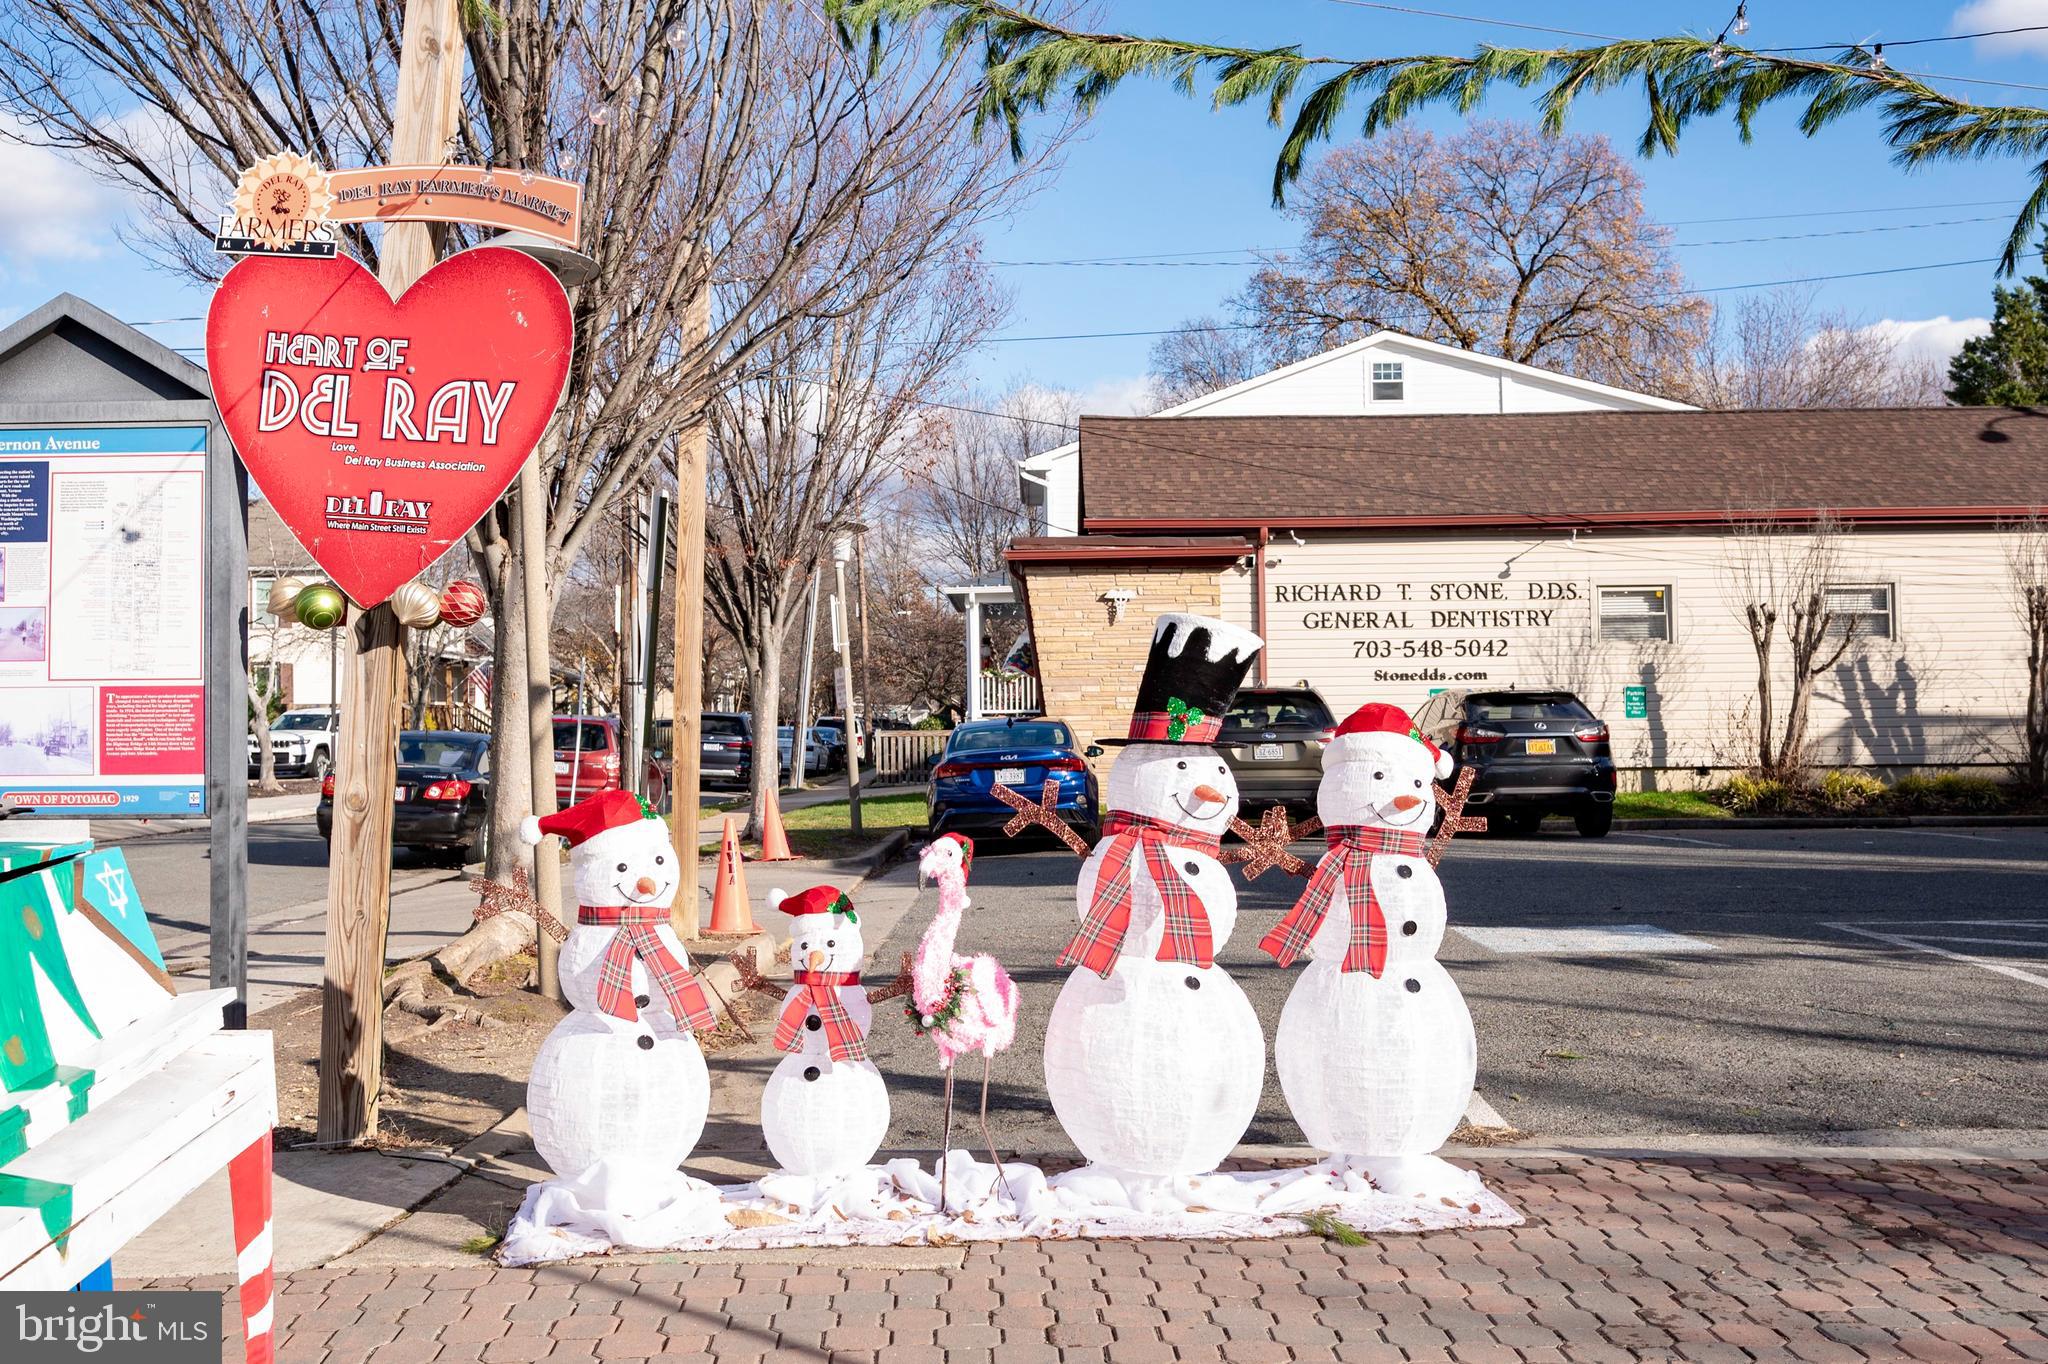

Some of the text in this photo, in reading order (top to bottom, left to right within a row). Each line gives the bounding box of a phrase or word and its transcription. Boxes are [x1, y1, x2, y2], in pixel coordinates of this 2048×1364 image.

[262, 175, 307, 191] DEL RAY
[339, 179, 574, 224] DEL RAY FARMER'S MARKET
[222, 240, 331, 253] MARKET
[264, 331, 409, 370] HEART OF
[258, 369, 518, 445] DEL RAY
[0, 435, 100, 450] ernon Avenue
[331, 442, 358, 453] Love,
[344, 456, 486, 472] Del Ray Business Association
[325, 496, 432, 519] DEL RAY
[327, 520, 427, 534] Where Main Street Still Exists
[1275, 584, 1381, 603] RICHARD
[1396, 584, 1412, 601] T.
[1528, 582, 1583, 600] D.D.S.
[1303, 610, 1554, 629] GENERAL DENTISTRY
[1353, 639, 1509, 658] 703-548-5042
[1374, 668, 1488, 681] Stonedds.com
[43, 795, 60, 804] OF
[61, 794, 116, 804] POTOMAC
[122, 794, 139, 803] 1929
